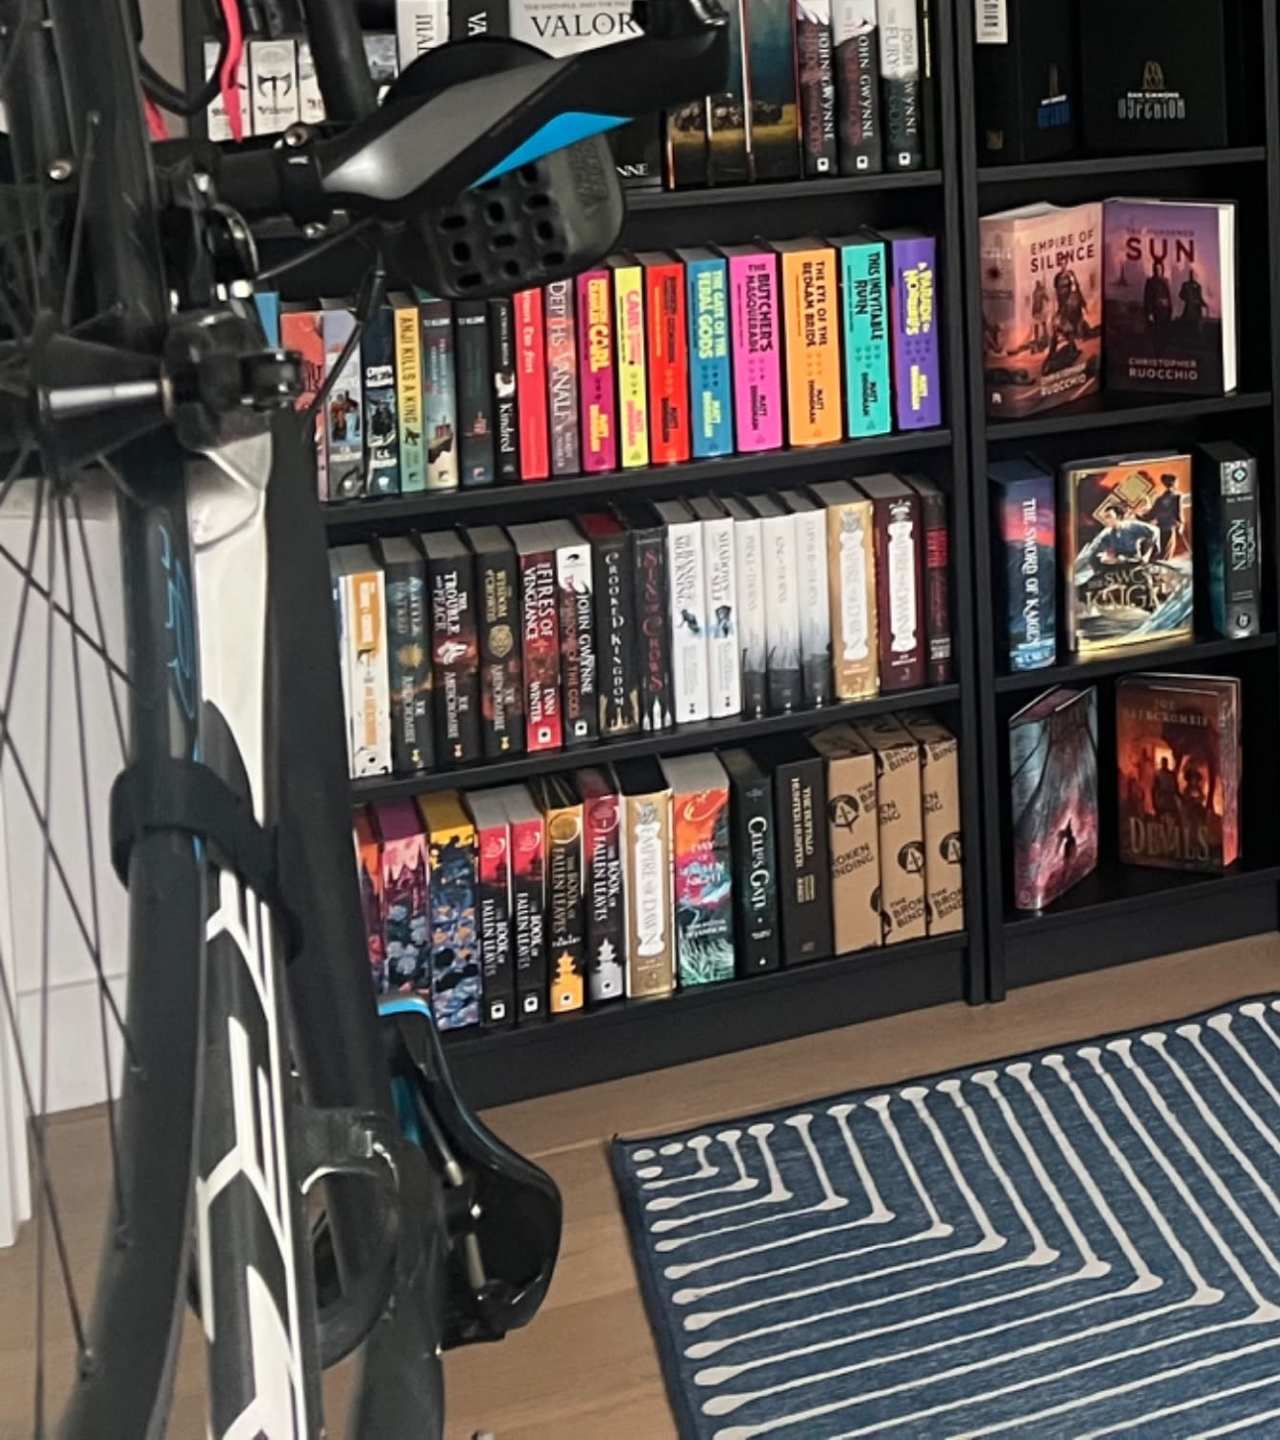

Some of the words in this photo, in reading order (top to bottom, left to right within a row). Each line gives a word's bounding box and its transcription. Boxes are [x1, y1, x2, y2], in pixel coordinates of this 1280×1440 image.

[530, 10, 637, 38] VALOR
[860, 75, 874, 139] GWYNNE
[1118, 97, 1186, 119] HYPERION
[1030, 236, 1074, 255] EMPIRE
[1079, 229, 1094, 246] OF
[1030, 244, 1096, 273] SILENCE
[1125, 237, 1195, 262] SUN
[815, 261, 826, 281] THE
[868, 253, 880, 275] THIS
[697, 272, 714, 313] FERAL
[712, 288, 724, 317] GATE
[803, 262, 816, 310] BEDLAM
[817, 286, 827, 304] EYE
[854, 280, 869, 315] RUIN
[548, 282, 570, 346] DEPTHS
[745, 275, 760, 354] MASQUERADE
[758, 273, 772, 352] BUTCHER'S
[817, 309, 827, 322] OF
[869, 278, 884, 340] INEVITABLE
[400, 317, 415, 344] ANJI
[697, 315, 716, 359] GODS
[714, 321, 725, 334] OF
[805, 314, 817, 348] BRIDE
[817, 326, 828, 346] THE
[401, 347, 416, 380] KILLS
[715, 337, 727, 358] THE
[1128, 358, 1197, 368] CHRISTOPHER
[403, 385, 418, 393] A
[1129, 368, 1198, 381] RUOCCHIO
[404, 396, 418, 423] KING
[758, 395, 767, 417] MATT
[815, 389, 824, 411] MATT
[868, 382, 878, 404] MATT
[500, 403, 514, 453] Kindred
[1023, 497, 1037, 523] THE
[1022, 525, 1039, 576] SWORD
[1231, 519, 1247, 571] KAIGEN
[444, 571, 460, 634] TROUBLE
[457, 592, 469, 610] THE
[495, 571, 509, 618] WISDOM
[536, 571, 556, 618] FIRES
[605, 552, 624, 629] CROOKED
[1025, 577, 1040, 593] OF
[434, 589, 448, 631] PEACE
[524, 567, 541, 640] VENGEANCE
[576, 595, 589, 630] JOHN
[540, 619, 553, 637] OF
[1022, 597, 1041, 646] KAIGEN
[567, 666, 582, 685] THE
[578, 634, 594, 694] GWYNNE
[610, 633, 624, 707] KINGDOM
[401, 675, 417, 744] ABERCROMBIE
[415, 700, 426, 716] JOE
[444, 672, 460, 739] ABERCROMBIE
[457, 695, 469, 712] JOE
[491, 664, 506, 730] ABERCROMBIE
[504, 688, 515, 704] JOE
[529, 682, 544, 723] WINTER
[543, 688, 555, 716] EVAN
[791, 777, 801, 822] HUNTER
[802, 787, 813, 808] THE
[792, 823, 803, 868] HUNTER
[802, 810, 814, 856] BUFFALO
[1129, 817, 1210, 861] DEVILS
[552, 847, 566, 891] FALLEN
[593, 836, 607, 877] FALLEN
[566, 872, 578, 907] BOOK
[607, 861, 621, 894] BOOK
[482, 899, 496, 937] FALLEN
[517, 892, 531, 930] FALLEN
[552, 893, 567, 935] LEAVES
[594, 881, 608, 922] LEAVES
[495, 921, 508, 953] BOOK
[530, 914, 542, 947] BOOK
[642, 898, 657, 945] DAWN
[483, 940, 497, 977] LEAVES
[517, 933, 531, 968] LEAVES
